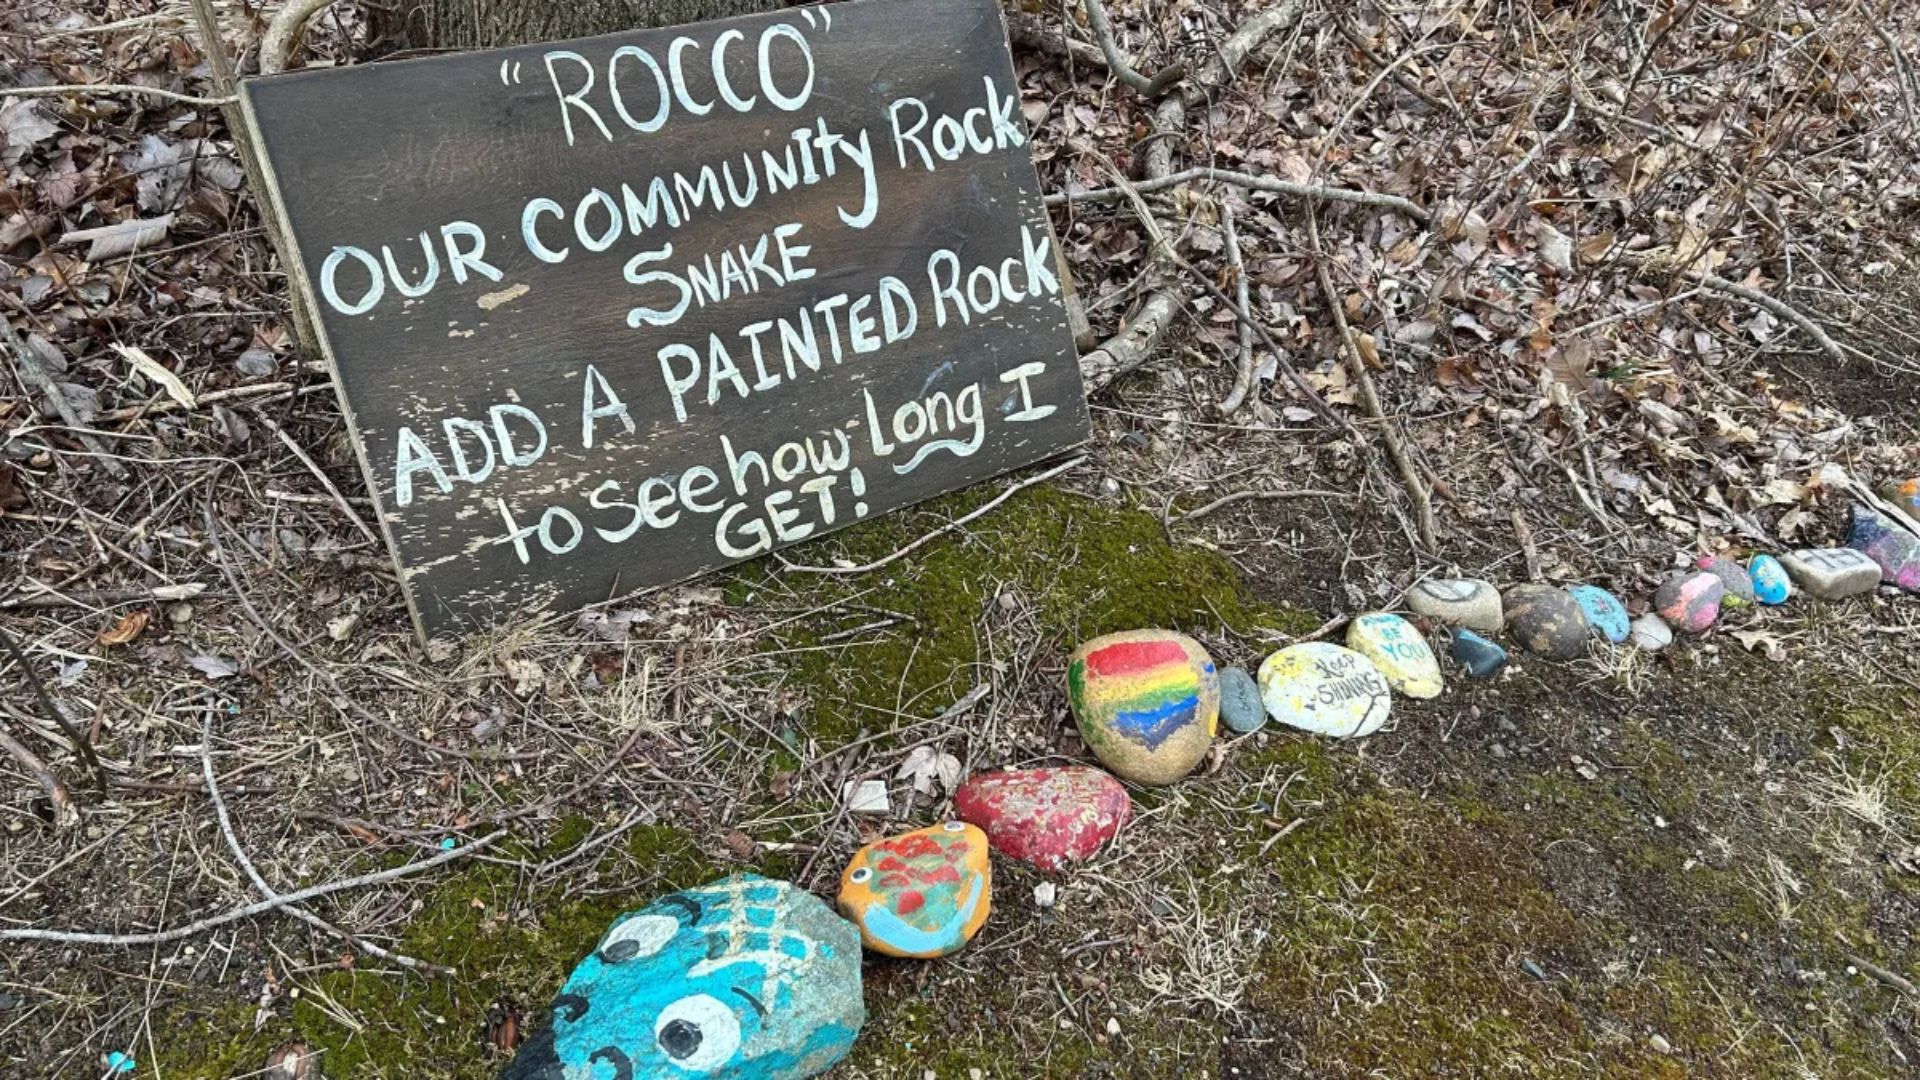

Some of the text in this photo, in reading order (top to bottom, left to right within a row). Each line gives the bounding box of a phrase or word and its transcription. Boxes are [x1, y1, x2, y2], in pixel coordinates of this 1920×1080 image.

[320, 220, 503, 315] OUR
[889, 75, 1026, 171] Rock
[623, 223, 816, 328] SNAKE
[396, 225, 1061, 506] ADD A PAINTED Rock
[492, 497, 583, 565] to
[720, 428, 850, 496] how
[999, 361, 1058, 422] I
[714, 466, 869, 558] GET!
[1380, 643, 1426, 661] YOU
